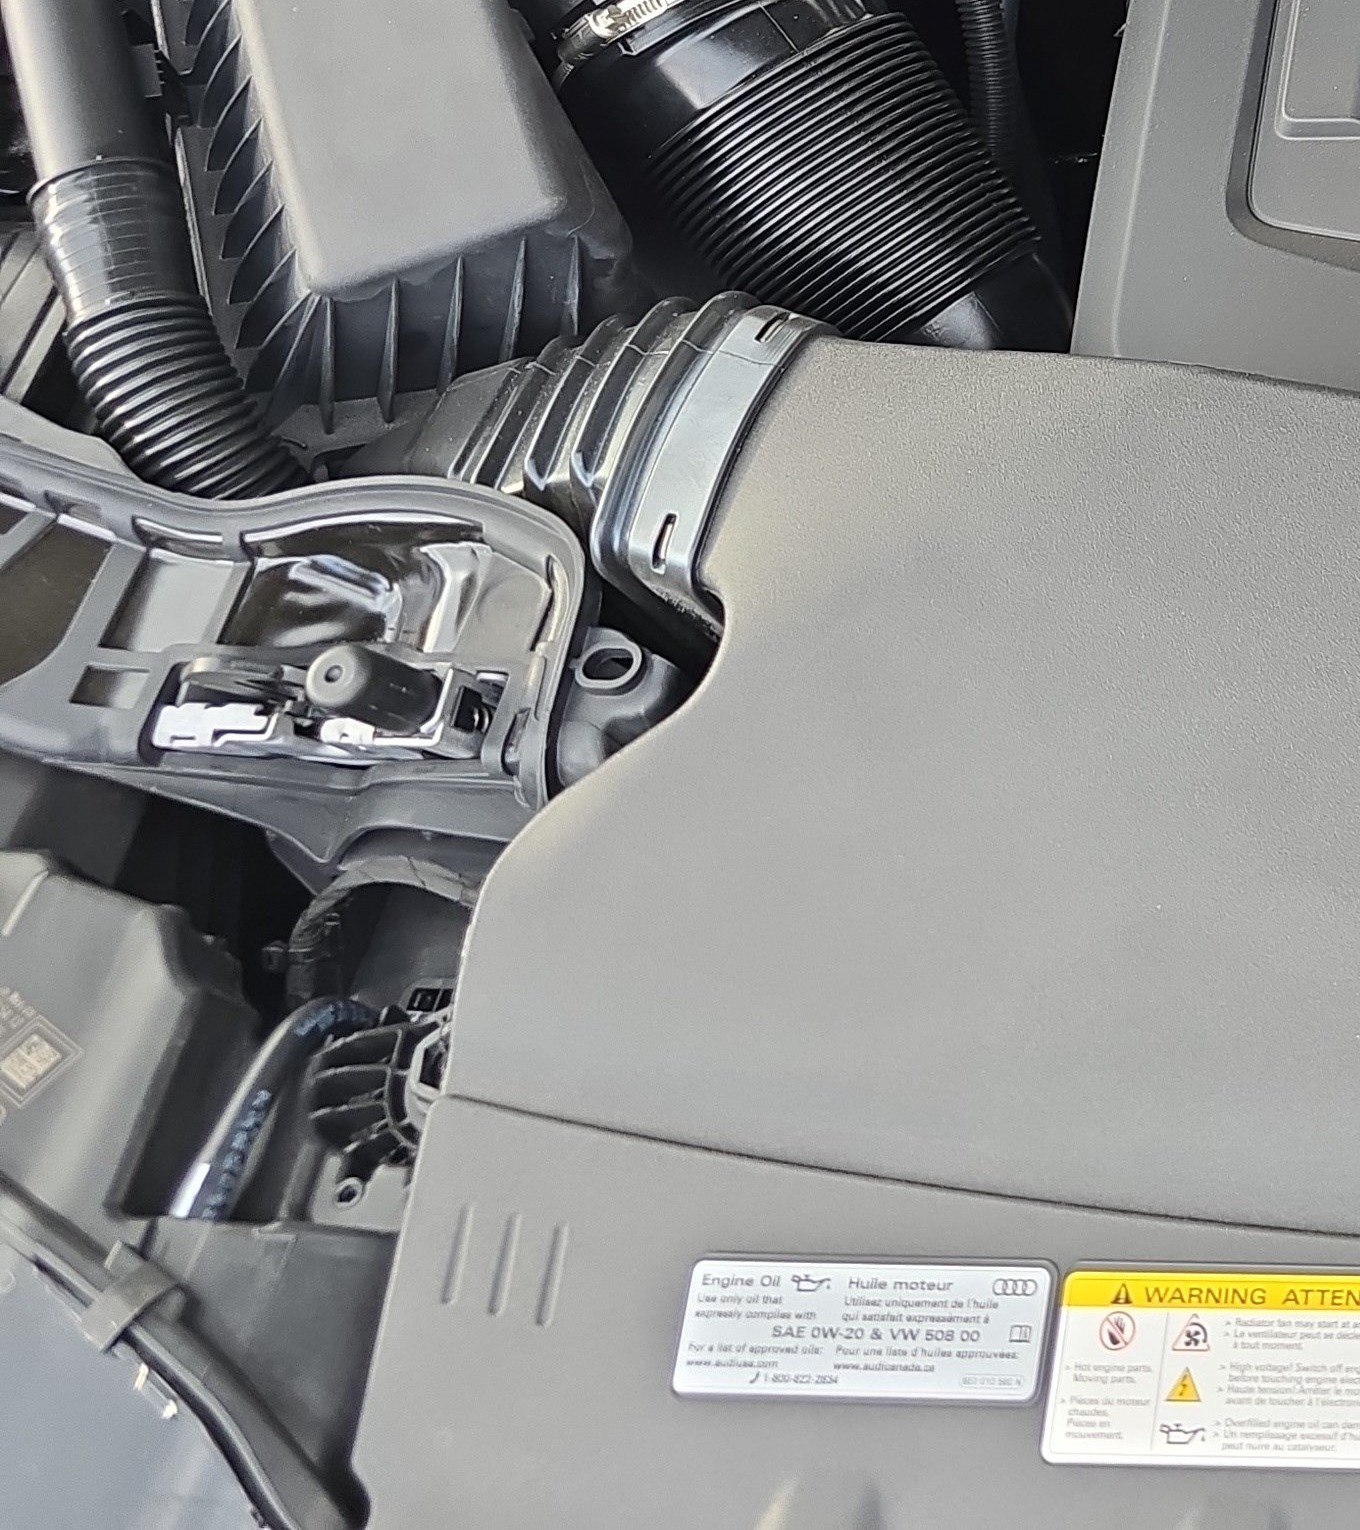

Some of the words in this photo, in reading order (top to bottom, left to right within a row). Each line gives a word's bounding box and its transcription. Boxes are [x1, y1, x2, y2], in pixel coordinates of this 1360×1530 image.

[700, 1272, 755, 1289] Engine
[758, 1274, 781, 1287] Oil
[847, 1276, 888, 1290] Huile
[892, 1278, 954, 1291] moteur
[1144, 1287, 1267, 1306] WARNING
[770, 1325, 807, 1338] SAE
[810, 1326, 864, 1339] 0W-20
[869, 1327, 883, 1340] &
[889, 1328, 920, 1341] VW
[924, 1329, 955, 1342] 508
[959, 1330, 981, 1342] 00
